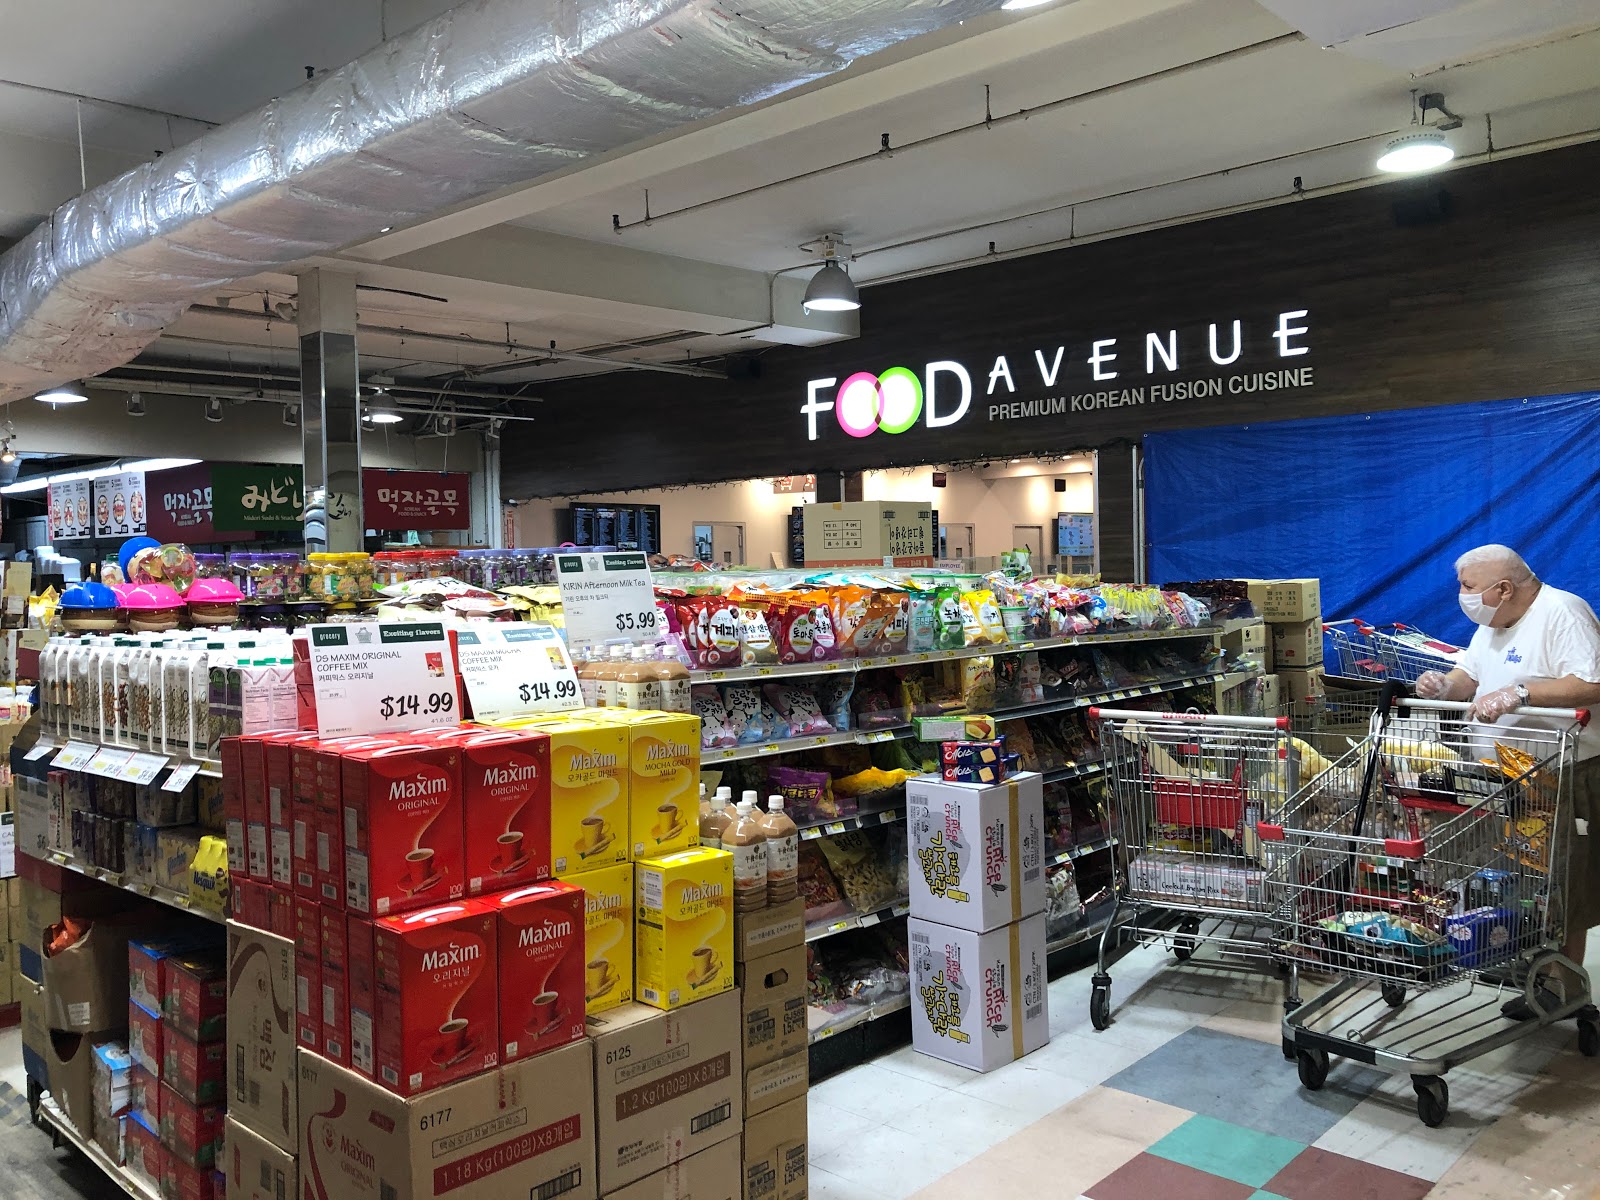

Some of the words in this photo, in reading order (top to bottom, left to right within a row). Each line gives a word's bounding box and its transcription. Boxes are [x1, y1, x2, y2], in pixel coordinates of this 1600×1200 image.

[800, 359, 973, 441] FOOD
[988, 309, 1310, 396] AVENUE
[988, 390, 1067, 421] PREMIUM
[1071, 386, 1146, 412] KOREAN
[1150, 377, 1224, 403] FUSION
[1229, 366, 1315, 396] CUISINE
[377, 489, 460, 516] 먹자골목
[562, 582, 583, 591] KIRIN
[584, 581, 619, 590] Afternoon
[616, 612, 656, 633] $5.99
[320, 632, 340, 641] grocery
[383, 630, 414, 638] Exciting
[316, 654, 328, 663] DS
[330, 652, 360, 662] MAXIM
[362, 651, 402, 660] ORIGINAL
[317, 663, 351, 672] COFFEE
[352, 662, 368, 670] MIX
[519, 680, 576, 704] $14.99
[380, 692, 453, 721] $14.99
[647, 739, 690, 761] Maxim
[944, 747, 974, 760] 에이스
[570, 748, 616, 772] Maxim
[645, 762, 670, 772] MOCHA
[672, 758, 690, 766] GOLD
[483, 760, 537, 787] Maxim
[659, 768, 676, 777] MILD
[946, 765, 974, 778] 에이스
[389, 773, 448, 800] Maxim
[490, 783, 530, 796] ORIGINAL
[398, 797, 440, 812] ORIGINAL
[688, 835, 698, 844] 100
[616, 850, 626, 858] 100
[536, 864, 548, 876] 100
[450, 884, 463, 894] 100
[682, 880, 724, 904] Maxim
[518, 919, 571, 948] Maxim
[422, 943, 480, 972] Maxim
[526, 941, 564, 958] ORIGINAL
[722, 976, 732, 986] 100
[572, 1024, 583, 1034] 100
[260, 1018, 276, 1072] 맥심
[484, 1052, 496, 1064] 100
[606, 1045, 632, 1065] 6125
[302, 1066, 318, 1084] 6177
[420, 1108, 452, 1132] 6177
[341, 1135, 376, 1172] Maxim
